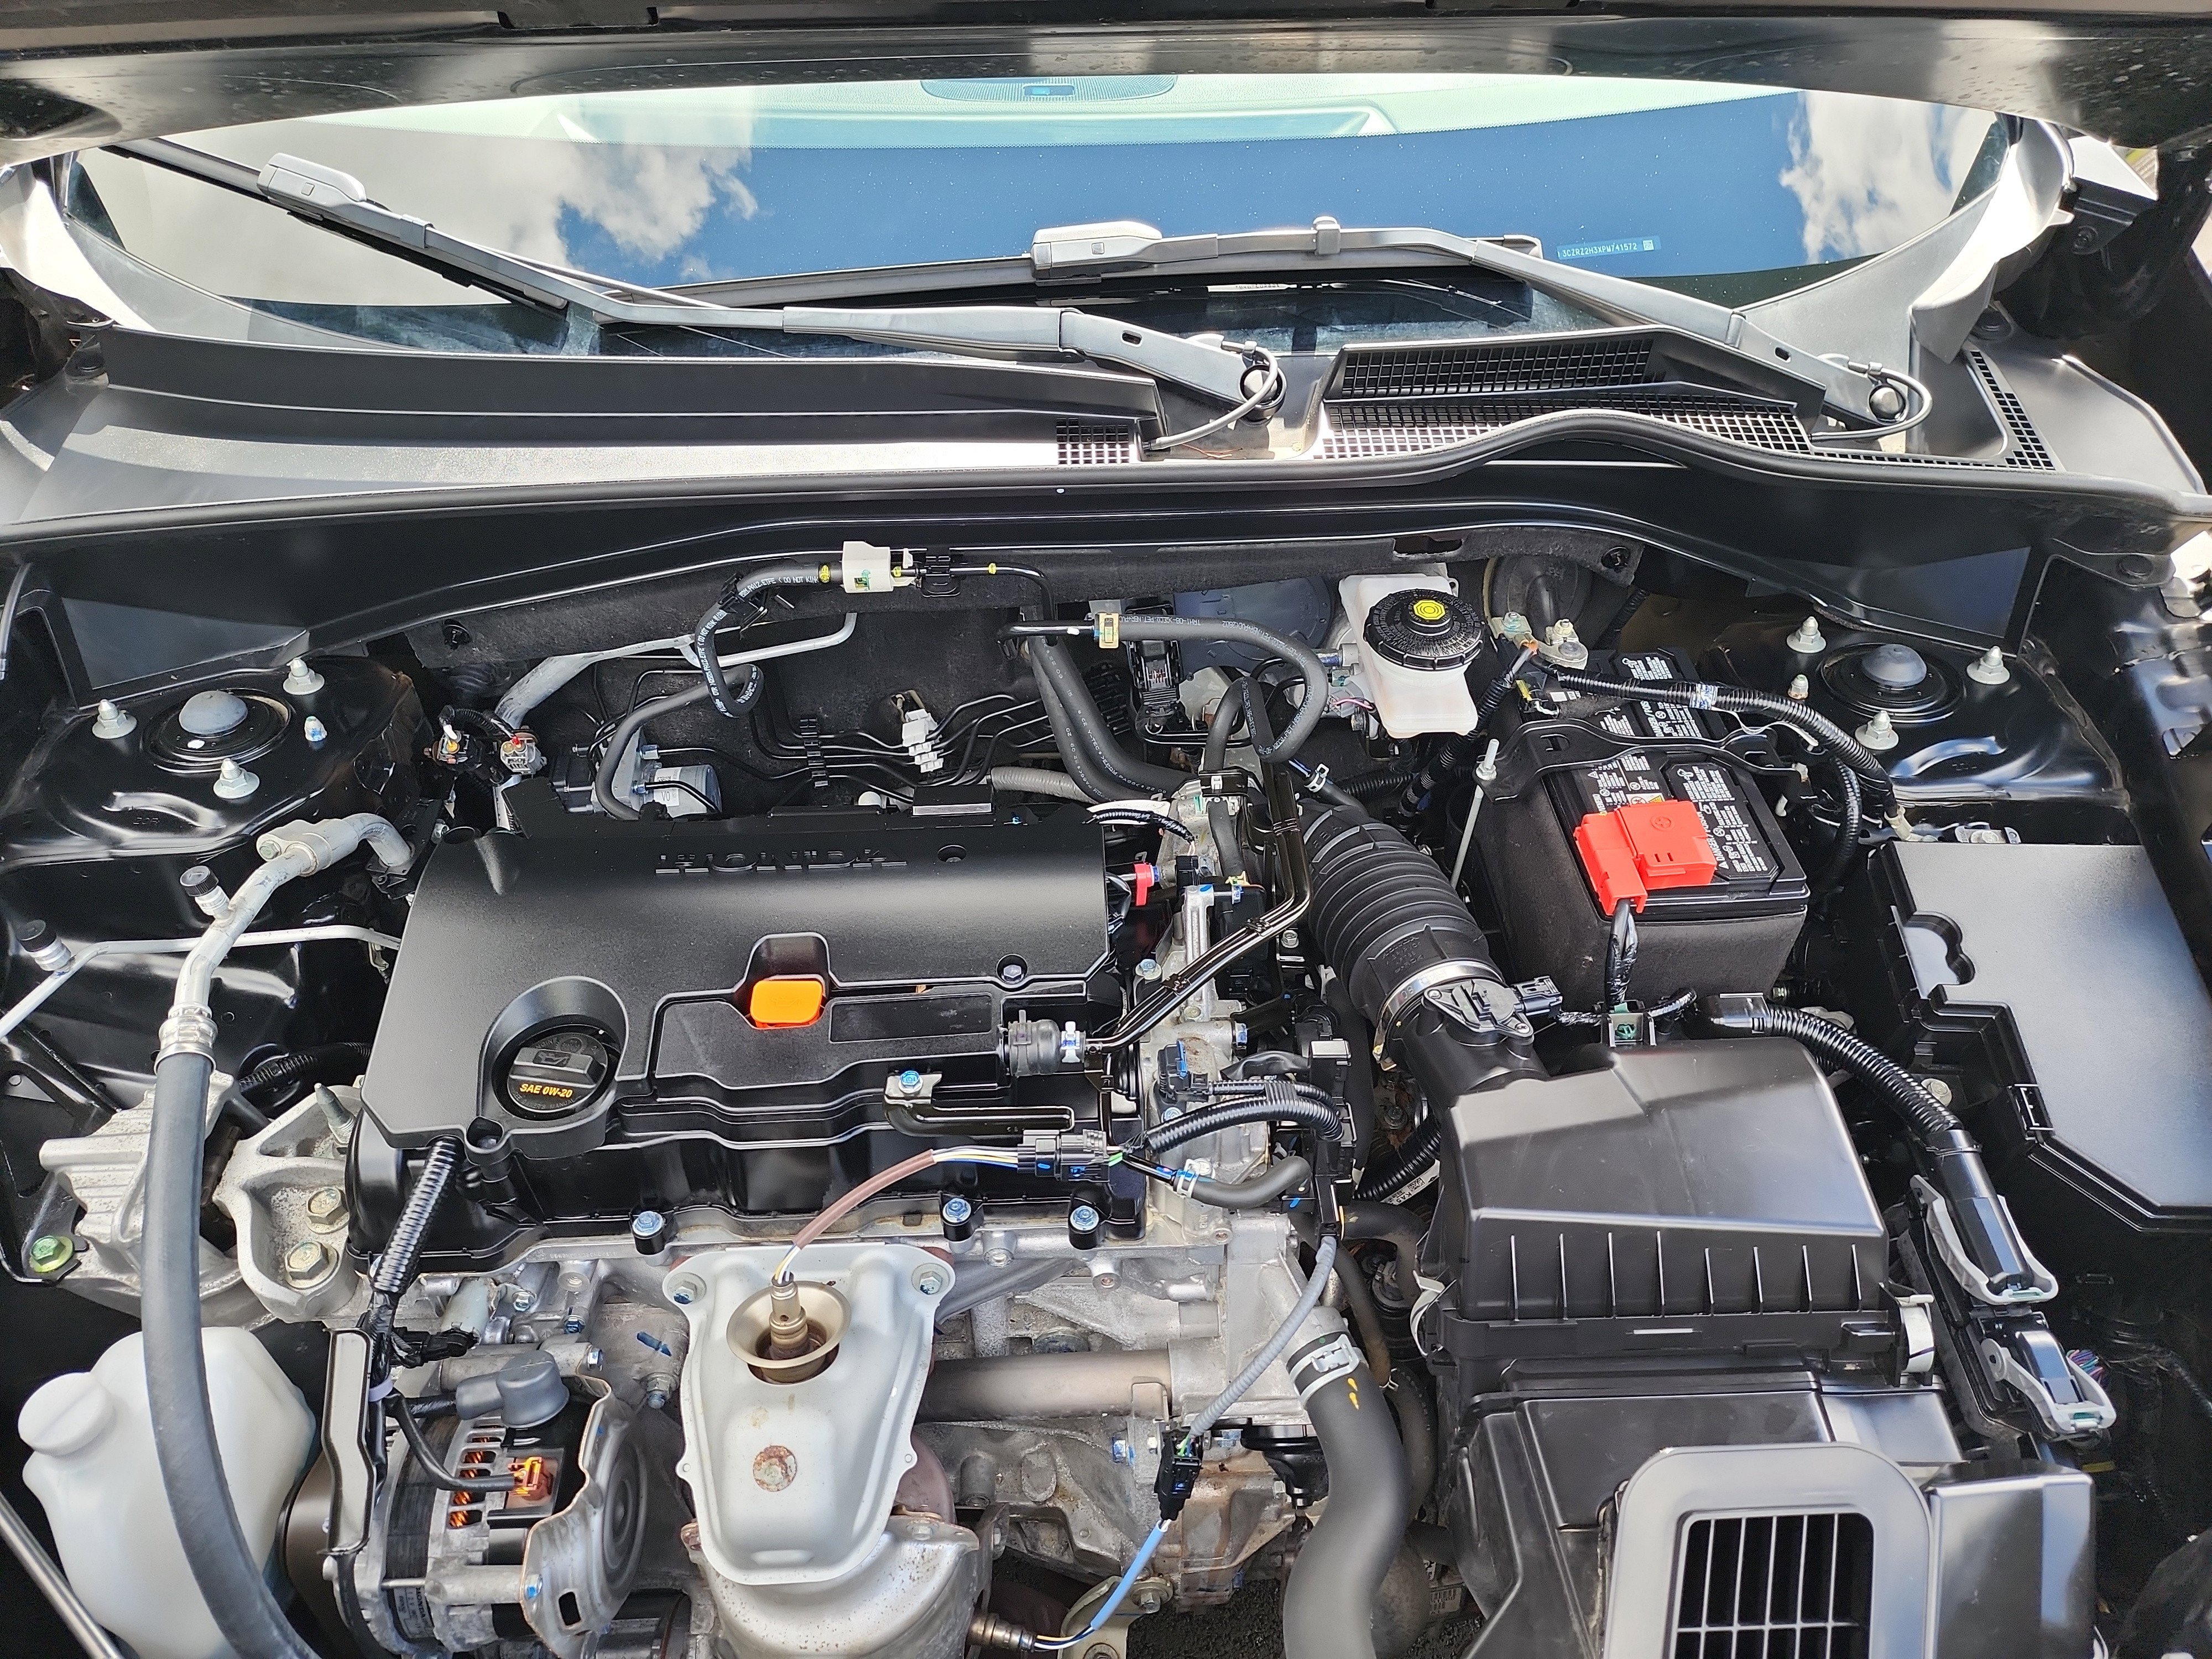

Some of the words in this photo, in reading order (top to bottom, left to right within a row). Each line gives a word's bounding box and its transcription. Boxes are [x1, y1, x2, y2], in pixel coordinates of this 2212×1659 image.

[805, 575, 820, 584] KINK
[655, 848, 907, 873] HONDA
[519, 1083, 542, 1094] SAE
[542, 1086, 573, 1098] 0W-20
[549, 1097, 576, 1109] MANUAL
